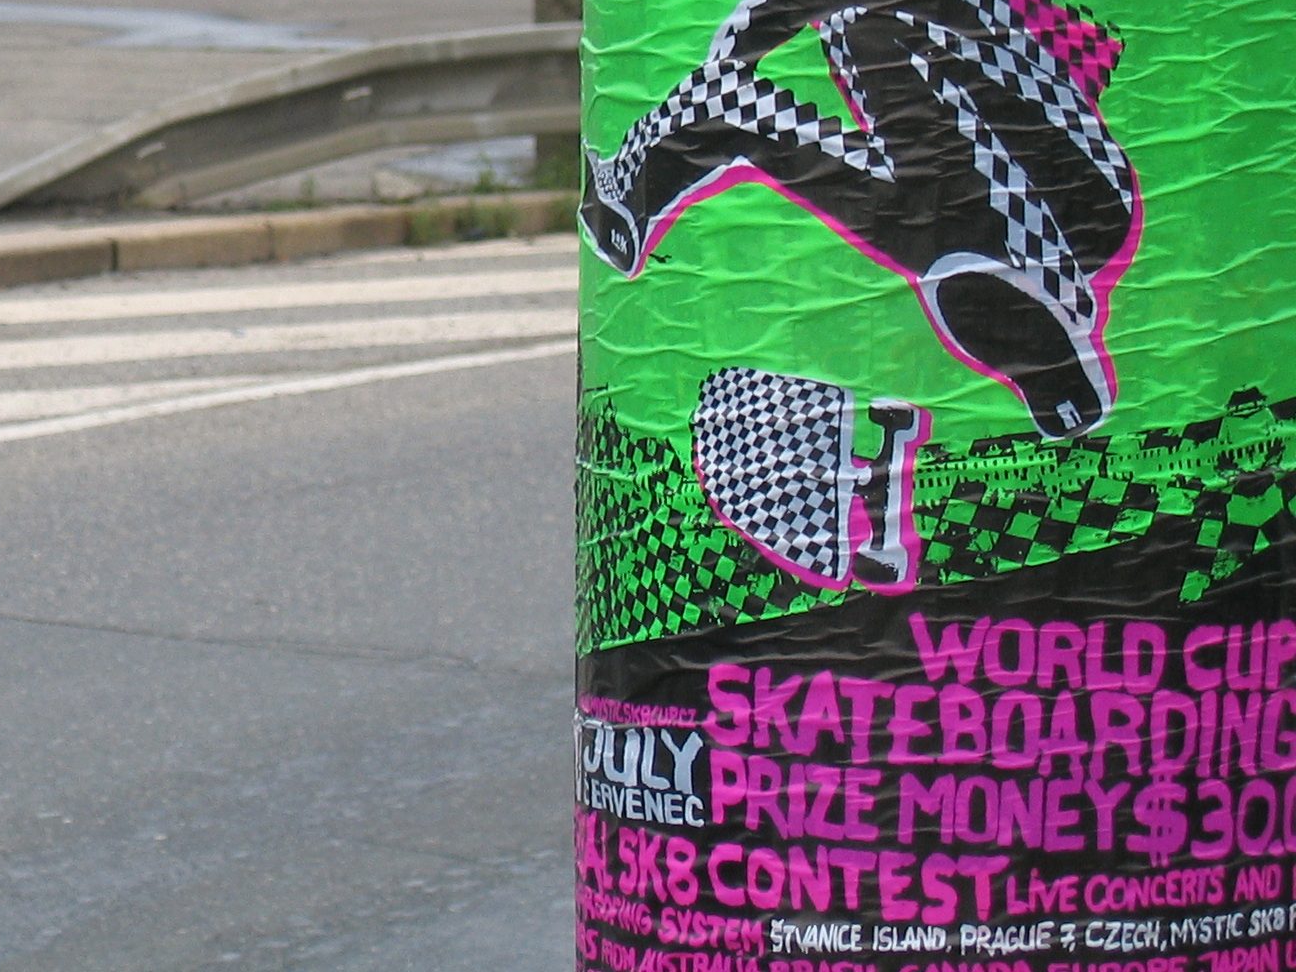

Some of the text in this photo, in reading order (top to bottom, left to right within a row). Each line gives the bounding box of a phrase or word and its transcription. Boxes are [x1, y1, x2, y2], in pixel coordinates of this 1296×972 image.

[908, 611, 1296, 694] WORLD CUP
[583, 720, 703, 795] JULY
[705, 663, 1296, 780] SKATEBOARDING
[709, 749, 884, 843] PRIZE
[897, 772, 1132, 852] MONEY
[618, 827, 699, 907] SK8
[707, 843, 1010, 925] CONTEST
[1083, 864, 1226, 914] CONCERTS
[1233, 863, 1282, 902] AND
[657, 906, 766, 958] SYSTEM
[872, 925, 952, 954] ISLAND,
[960, 920, 1054, 957] PRAGUE
[1085, 920, 1168, 952] CZECH,
[1170, 911, 1244, 948] MYSTIC
[1247, 907, 1286, 937] SK8
